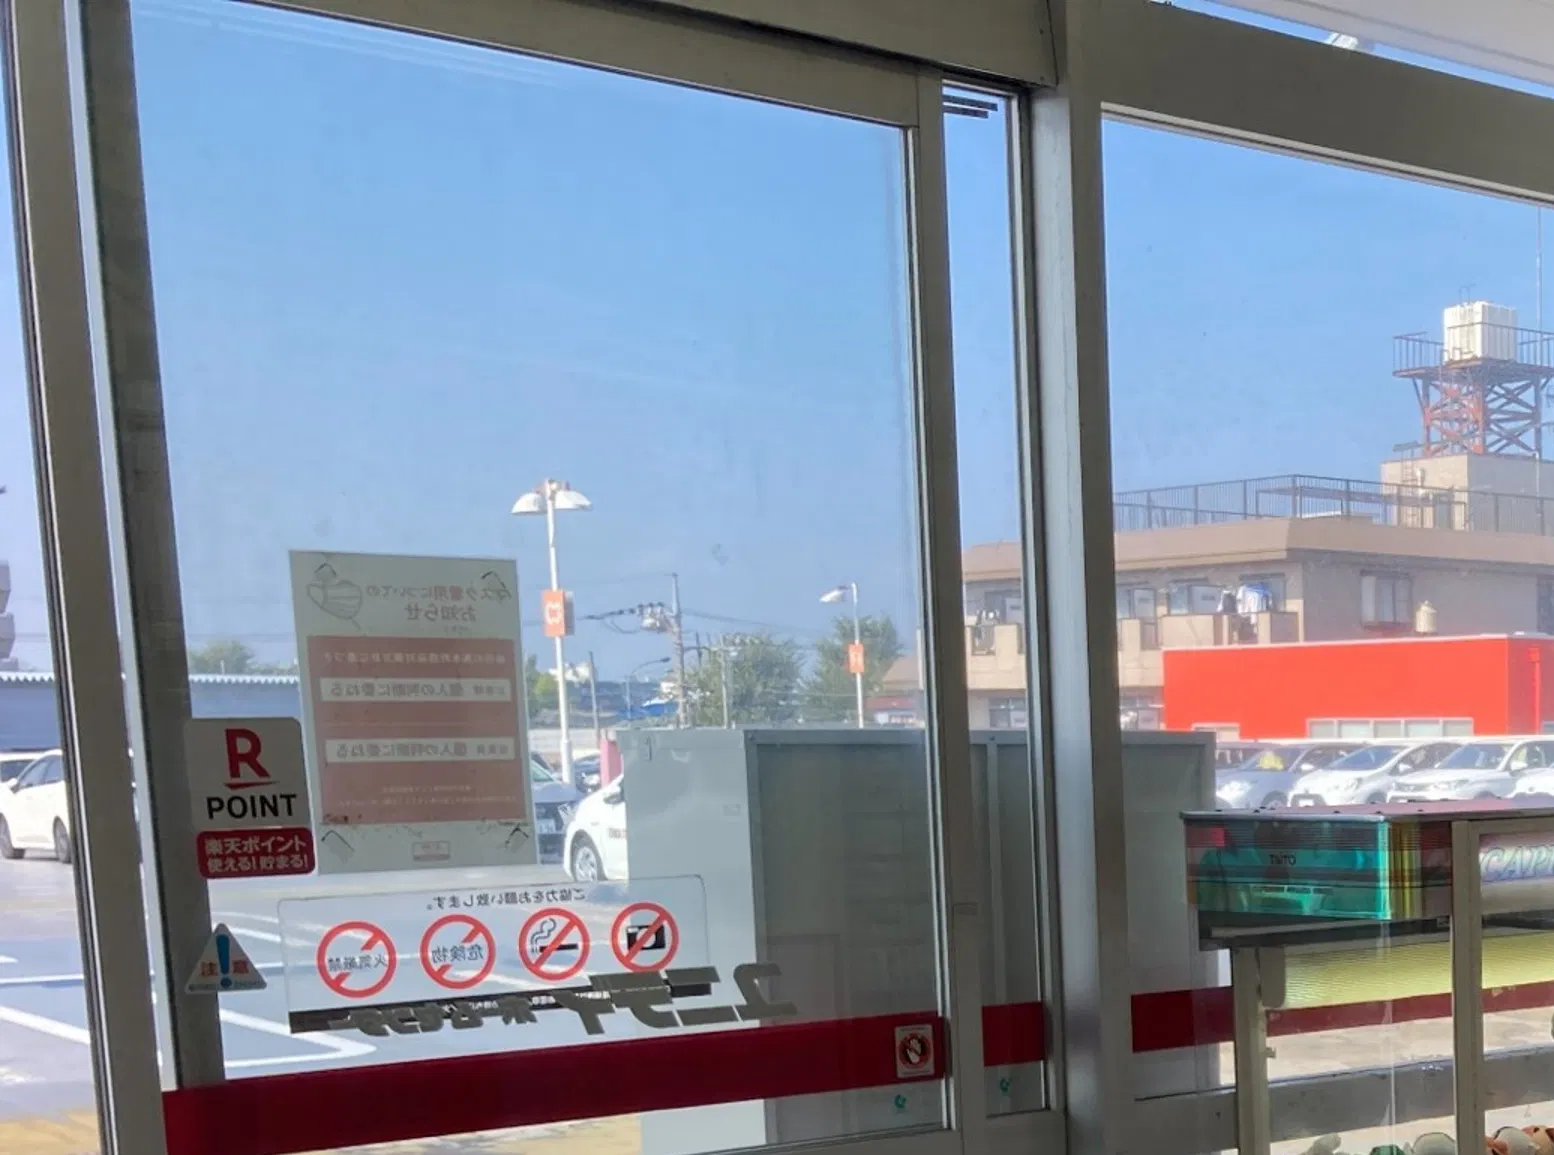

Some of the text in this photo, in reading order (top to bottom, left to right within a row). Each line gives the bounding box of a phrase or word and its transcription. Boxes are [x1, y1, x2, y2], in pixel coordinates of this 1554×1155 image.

[206, 794, 297, 820] POINT
[204, 834, 307, 855] 楽天ポイント
